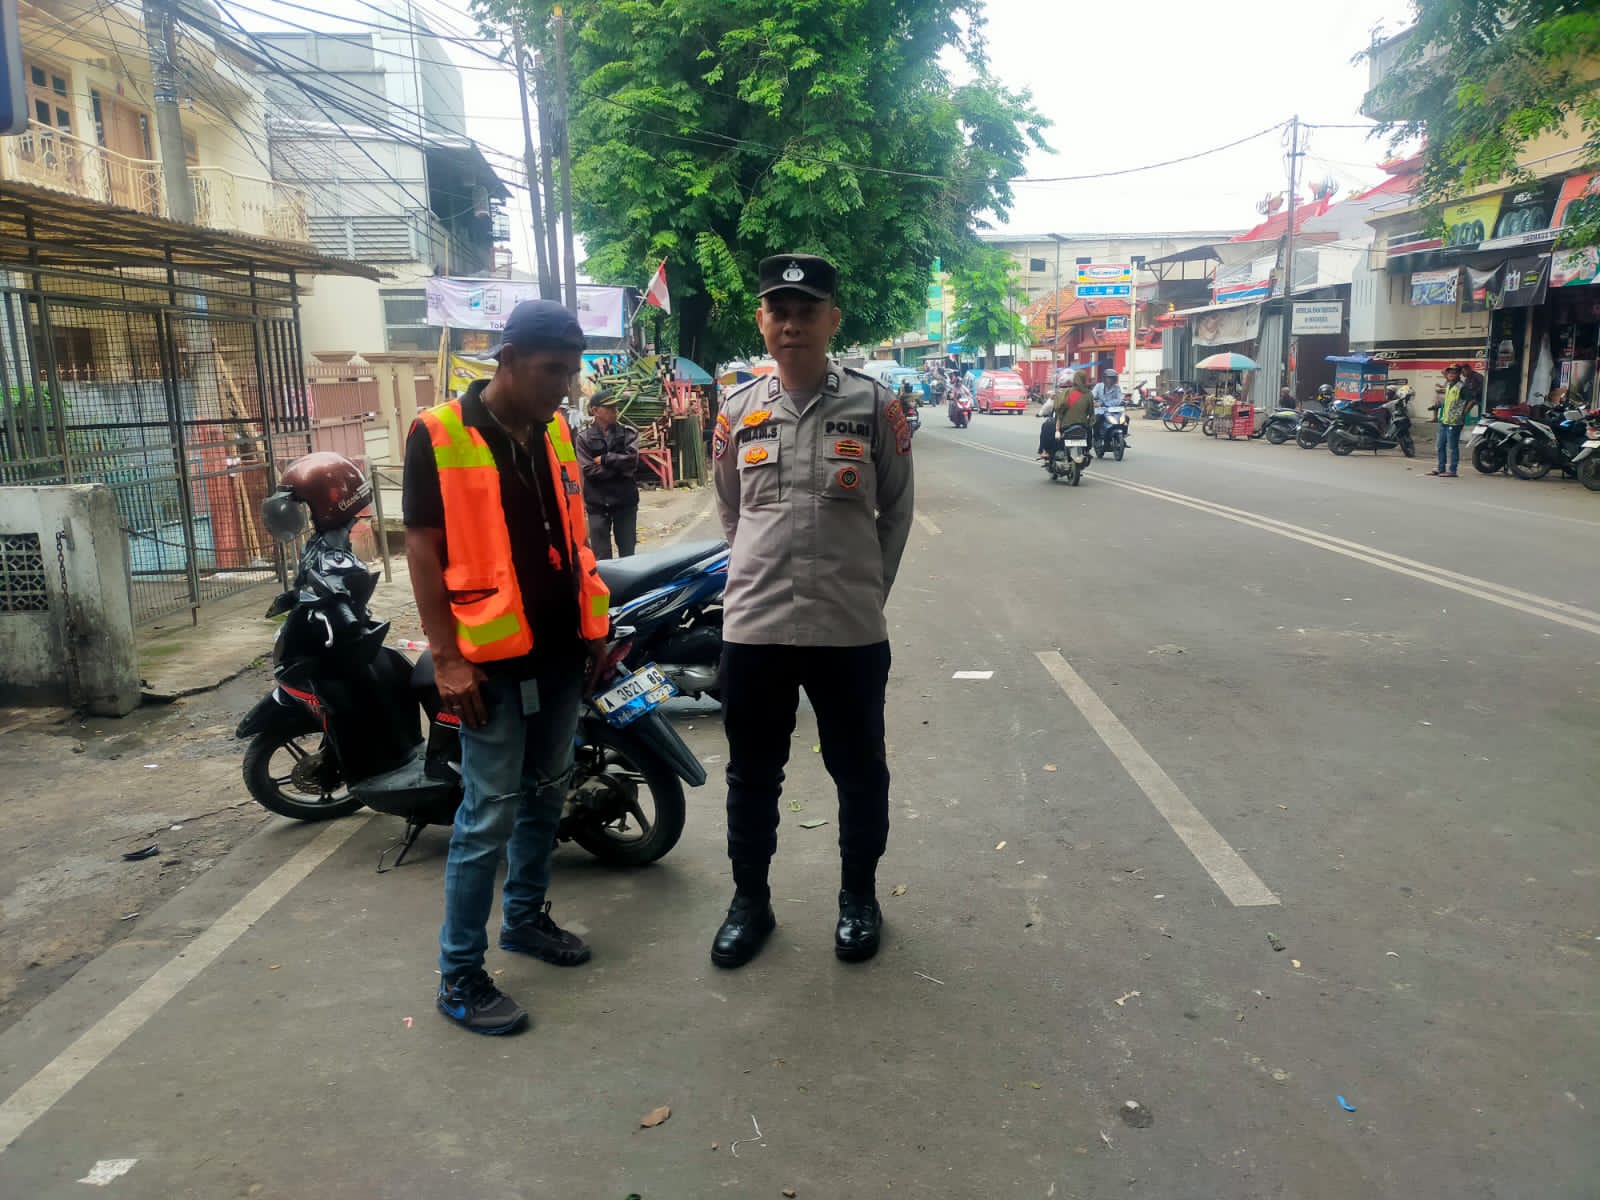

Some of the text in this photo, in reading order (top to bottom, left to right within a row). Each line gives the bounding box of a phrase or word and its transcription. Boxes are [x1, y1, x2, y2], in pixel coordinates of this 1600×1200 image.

[825, 422, 870, 437] POLRI
[604, 697, 615, 709] A
[616, 680, 644, 701] 3621
